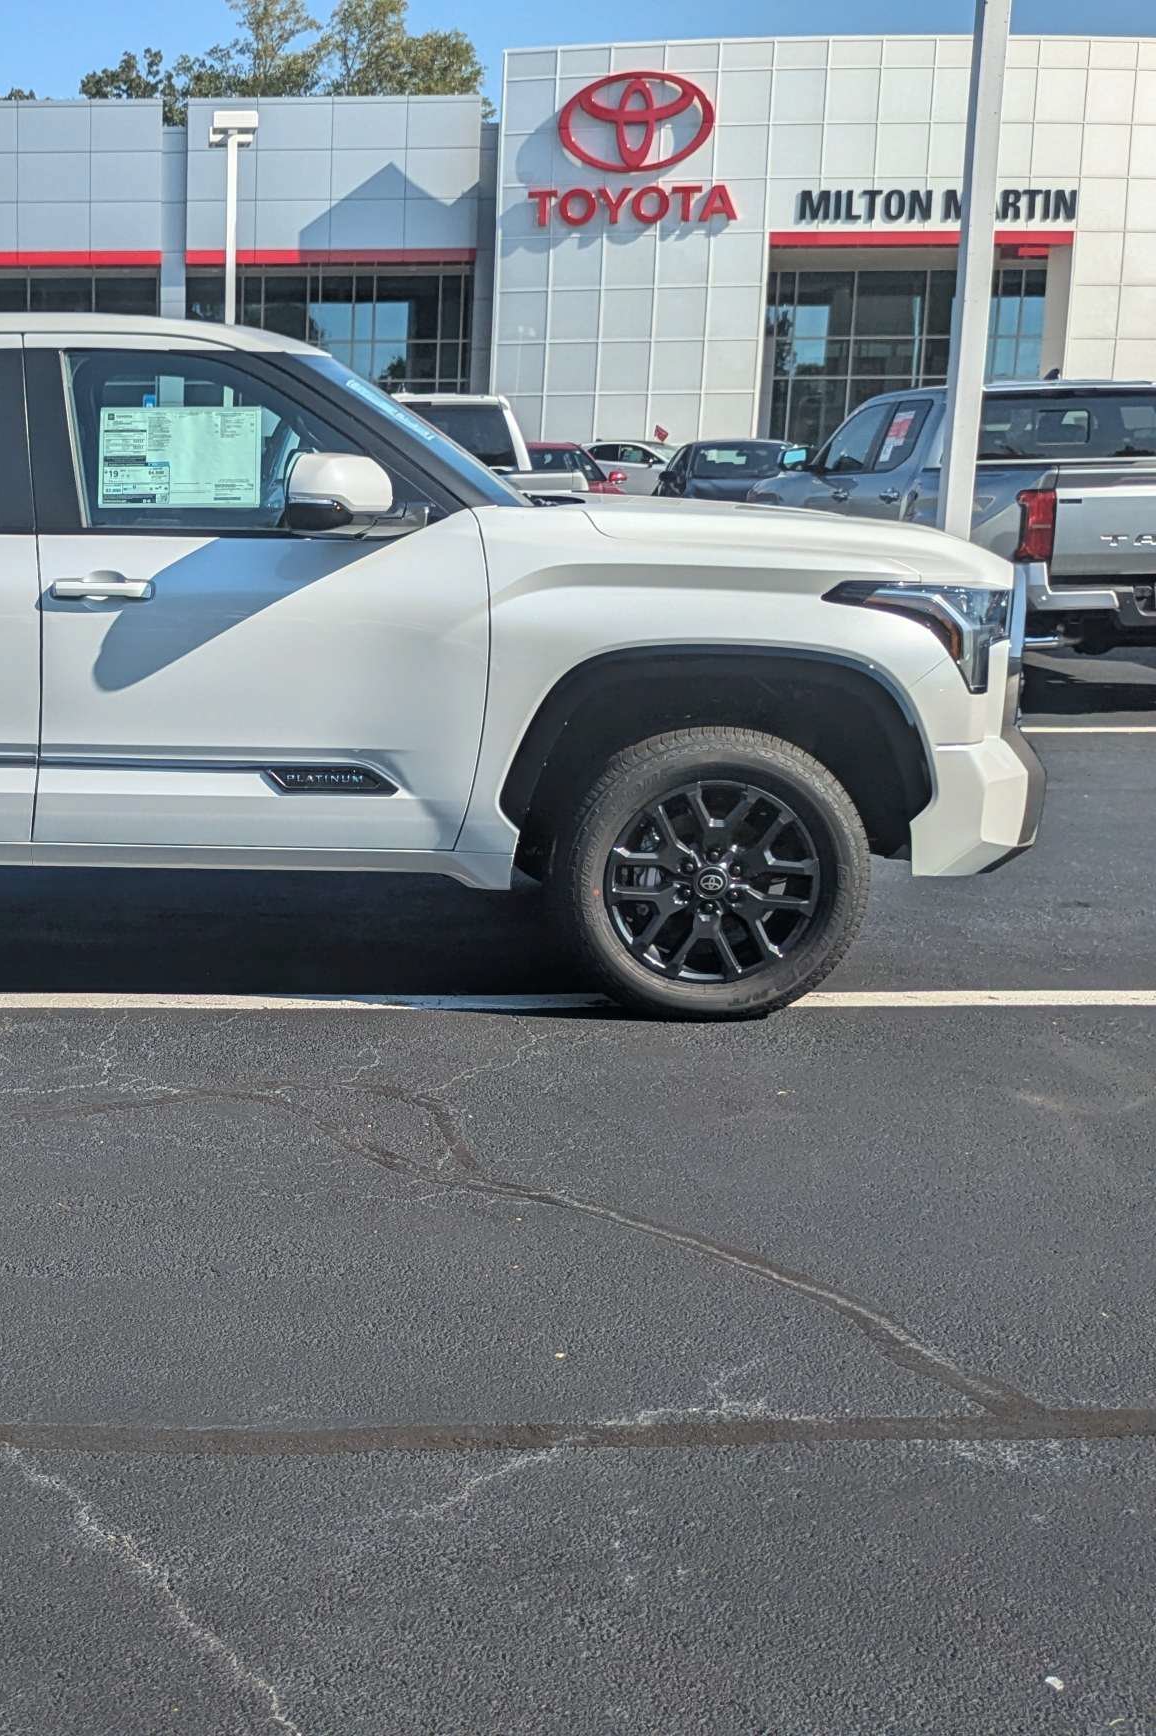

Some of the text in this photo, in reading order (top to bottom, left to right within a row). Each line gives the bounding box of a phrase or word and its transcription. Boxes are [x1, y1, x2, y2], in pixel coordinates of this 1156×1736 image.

[527, 185, 738, 227] TOYOTA
[798, 189, 1079, 221] MILTON MRTIN
[285, 773, 364, 783] PLATINUM
